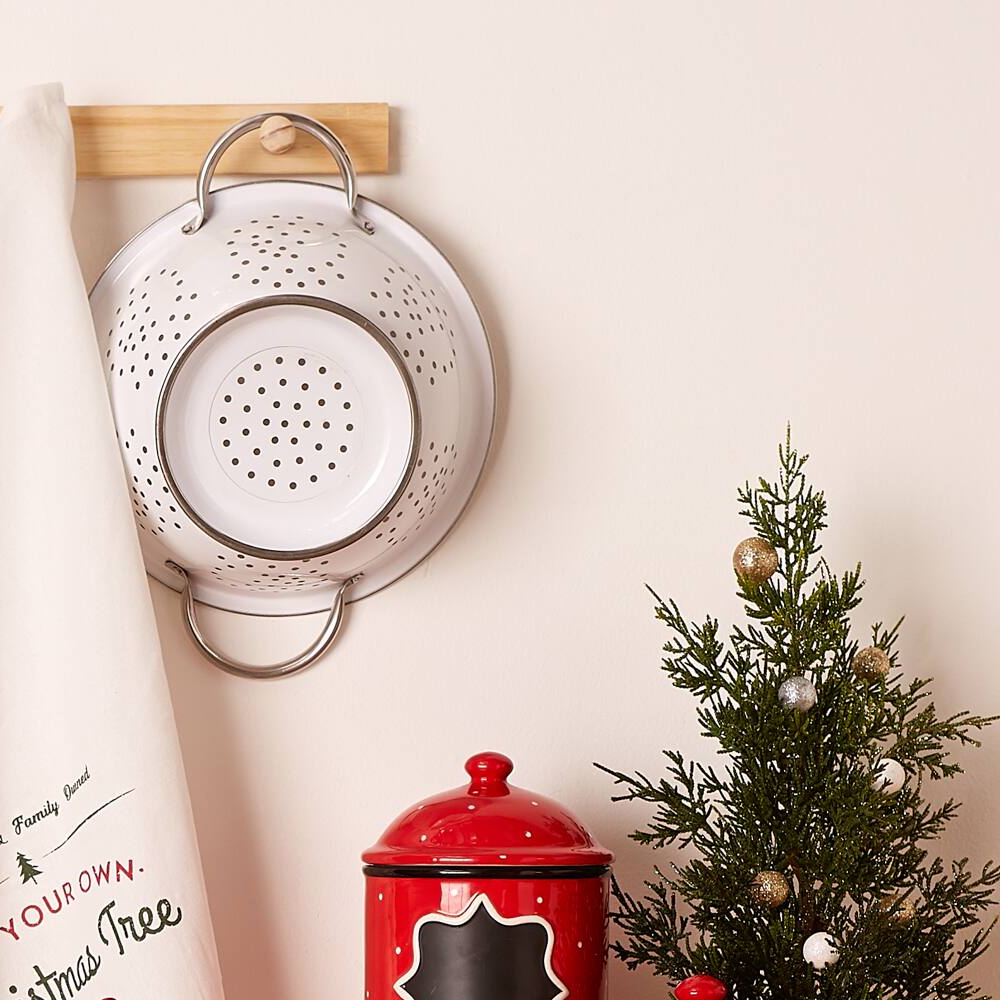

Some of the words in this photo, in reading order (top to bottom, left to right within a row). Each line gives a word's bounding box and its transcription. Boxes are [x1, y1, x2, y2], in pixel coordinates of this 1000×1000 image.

[12, 800, 60, 835] Family
[63, 764, 91, 801] Owned
[0, 881, 75, 942] YOUR
[98, 898, 182, 955] Tree
